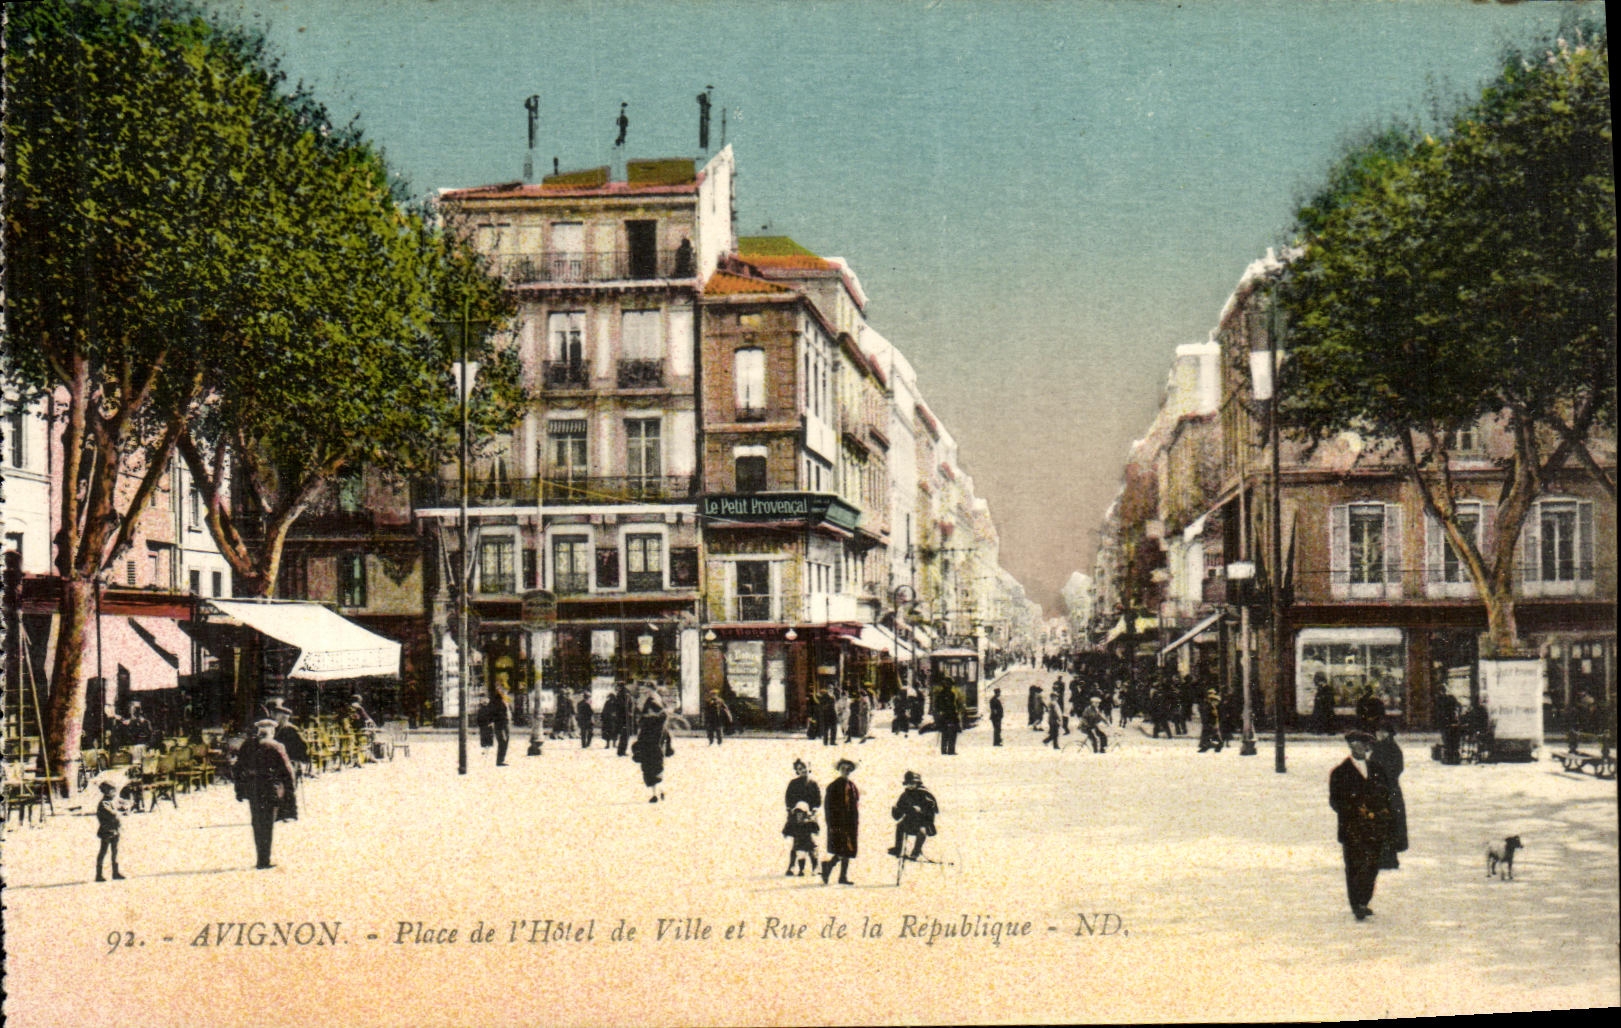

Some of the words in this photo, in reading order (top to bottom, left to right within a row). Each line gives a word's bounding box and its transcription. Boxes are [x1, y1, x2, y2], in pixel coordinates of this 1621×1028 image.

[704, 498, 719, 515] Le
[721, 497, 748, 514] Petit
[751, 497, 808, 516] Provençal
